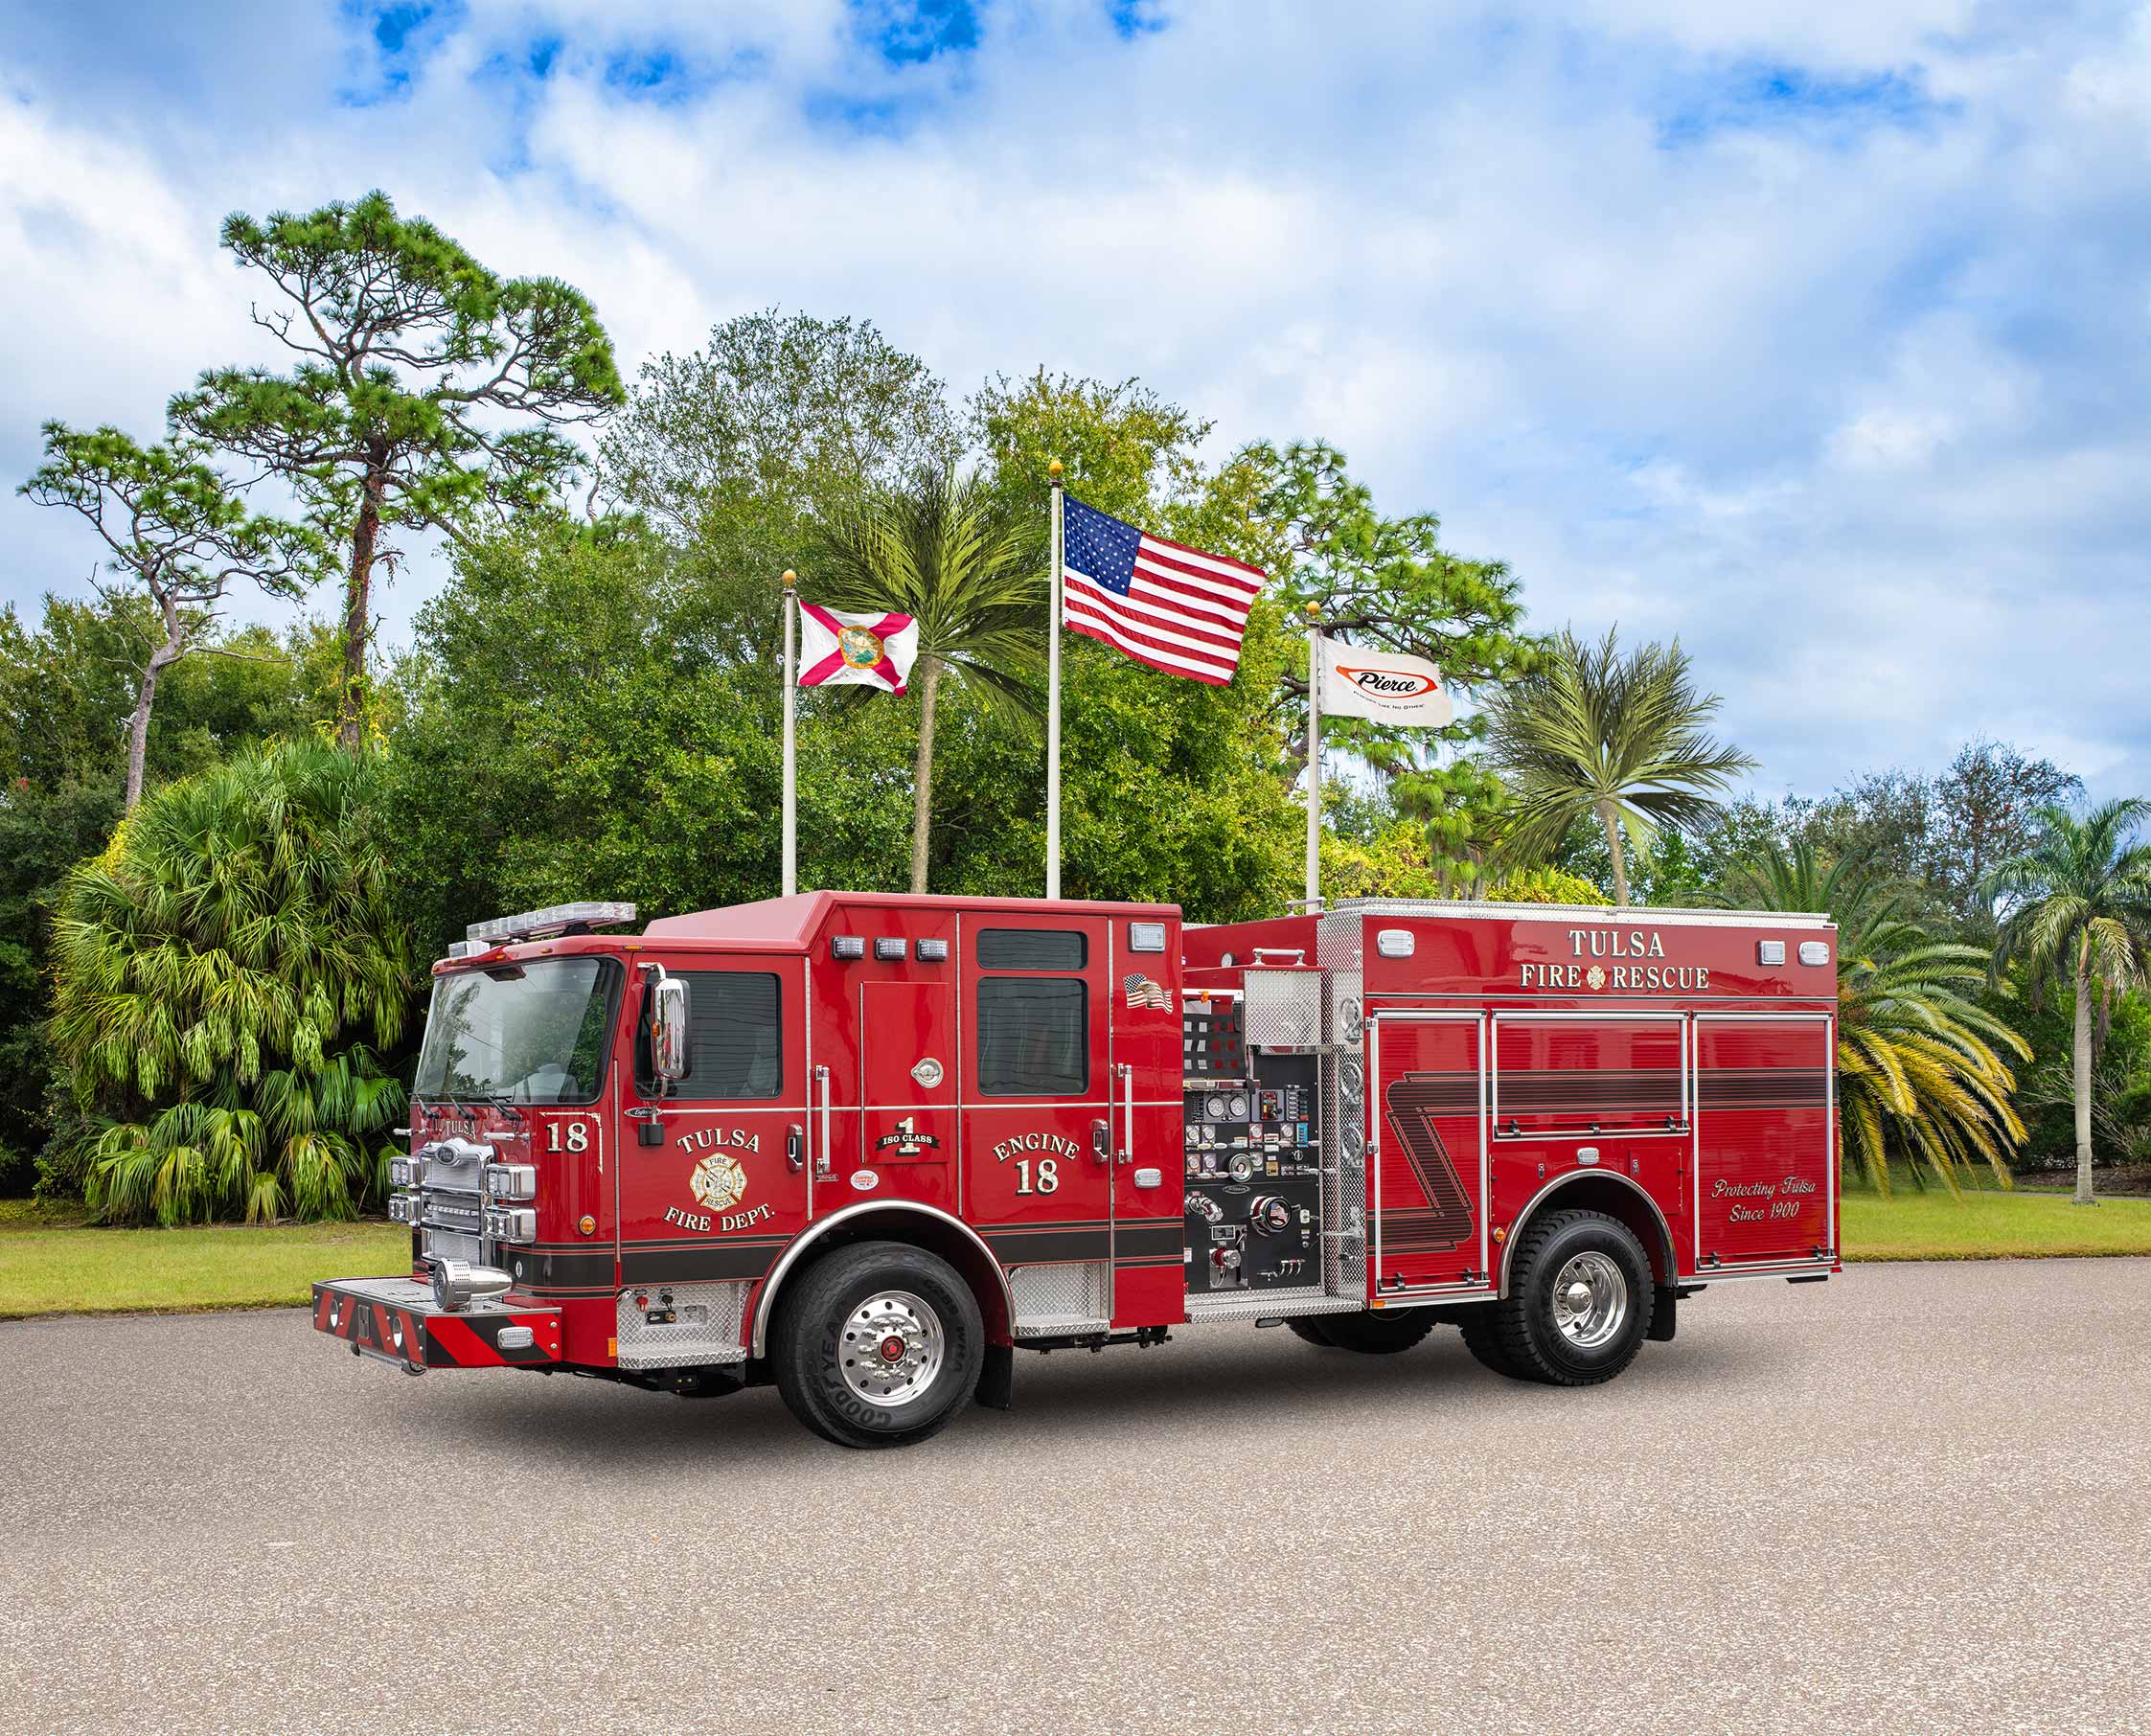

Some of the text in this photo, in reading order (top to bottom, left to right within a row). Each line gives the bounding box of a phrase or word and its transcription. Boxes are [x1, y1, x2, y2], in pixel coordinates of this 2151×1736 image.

[1357, 672, 1417, 693] Pierce
[1567, 929, 1665, 958] TULSA
[1520, 963, 1710, 991] FIRE RESCUE
[445, 1118, 477, 1141] TULSA
[545, 1121, 589, 1154] 18
[675, 1127, 760, 1154] TULSA
[881, 1133, 933, 1146] ISO CLASS
[895, 1116, 921, 1156] 1
[708, 1156, 728, 1166] FIRE
[992, 1131, 1081, 1164] ENGINE
[1014, 1157, 1059, 1197] 18
[1710, 1176, 1817, 1200] Protecting Tulsa
[704, 1196, 733, 1208] RESCUE
[1728, 1200, 1801, 1223] Since 1900
[662, 1201, 776, 1233] FIRE DEPT.
